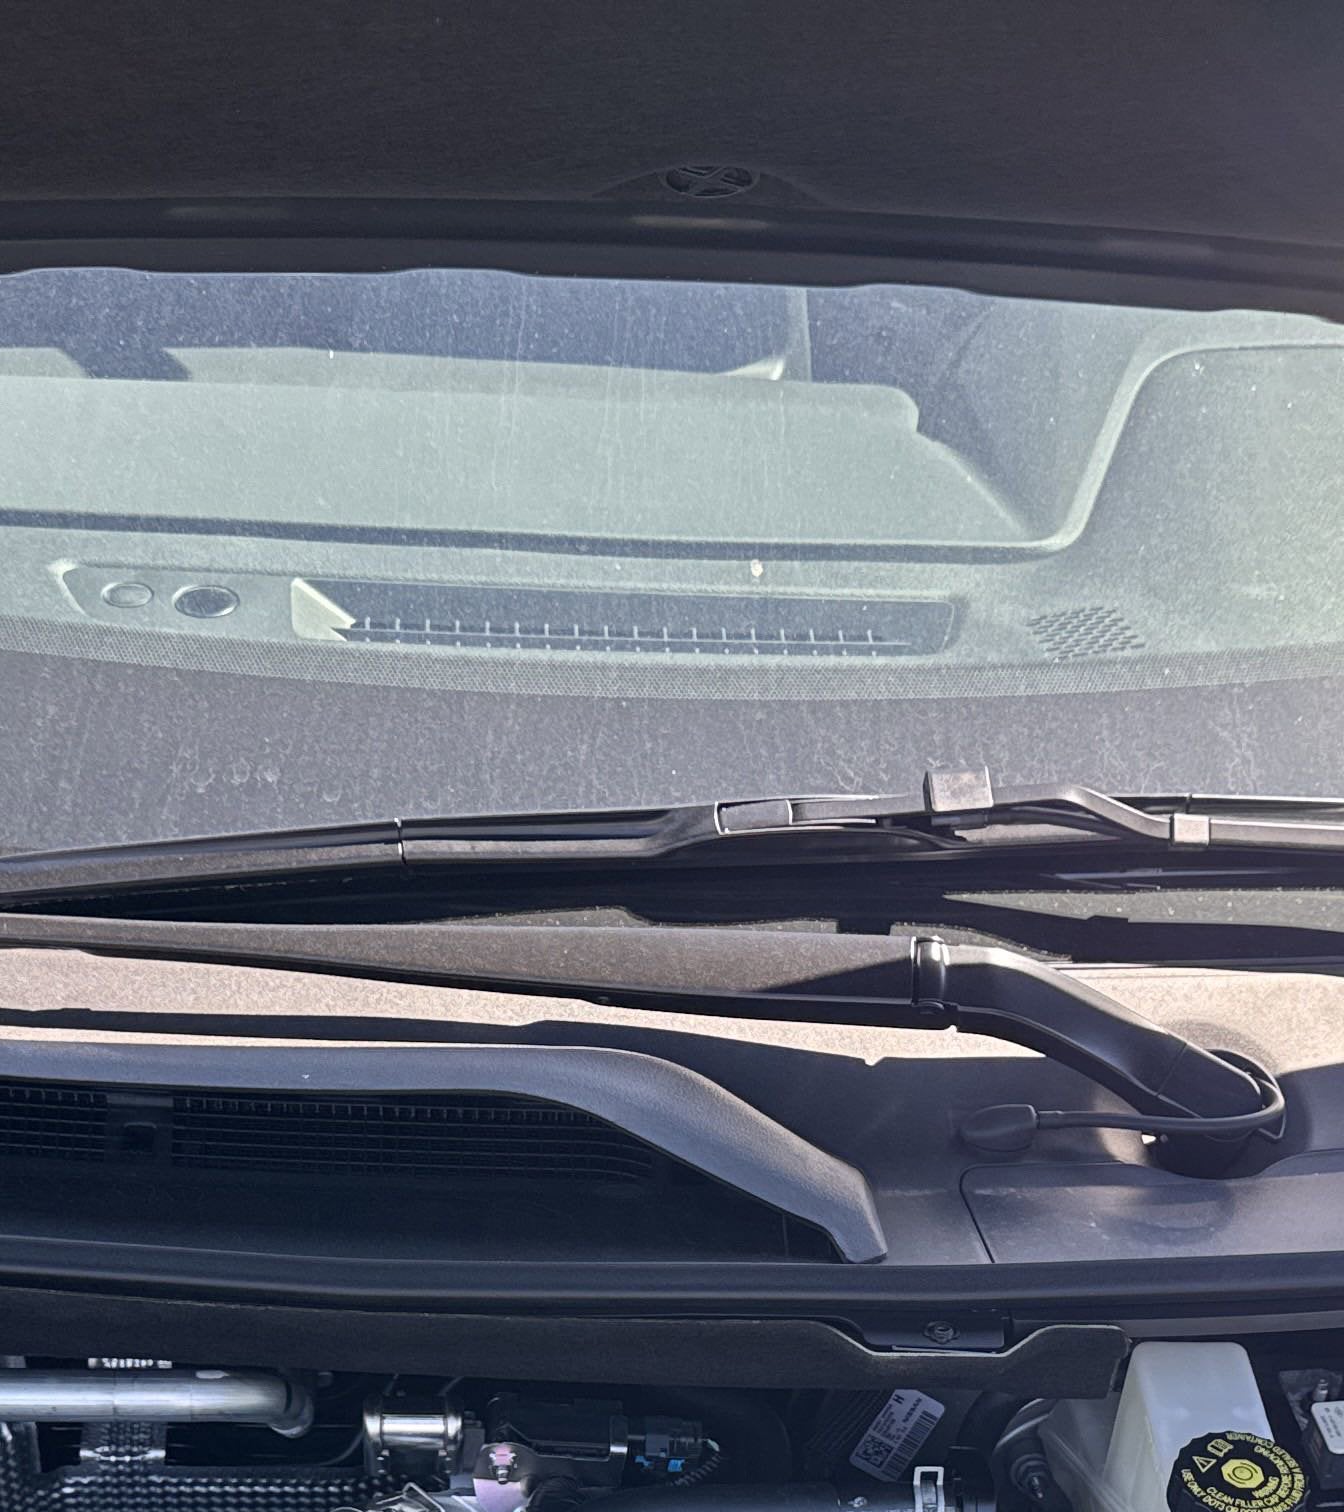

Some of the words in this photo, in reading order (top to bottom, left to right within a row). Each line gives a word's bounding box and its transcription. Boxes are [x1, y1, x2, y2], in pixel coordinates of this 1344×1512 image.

[1202, 1495, 1226, 1511] DOT3
[1206, 1487, 1235, 1504] CLEAN
[1235, 1498, 1264, 1508] FILLER
